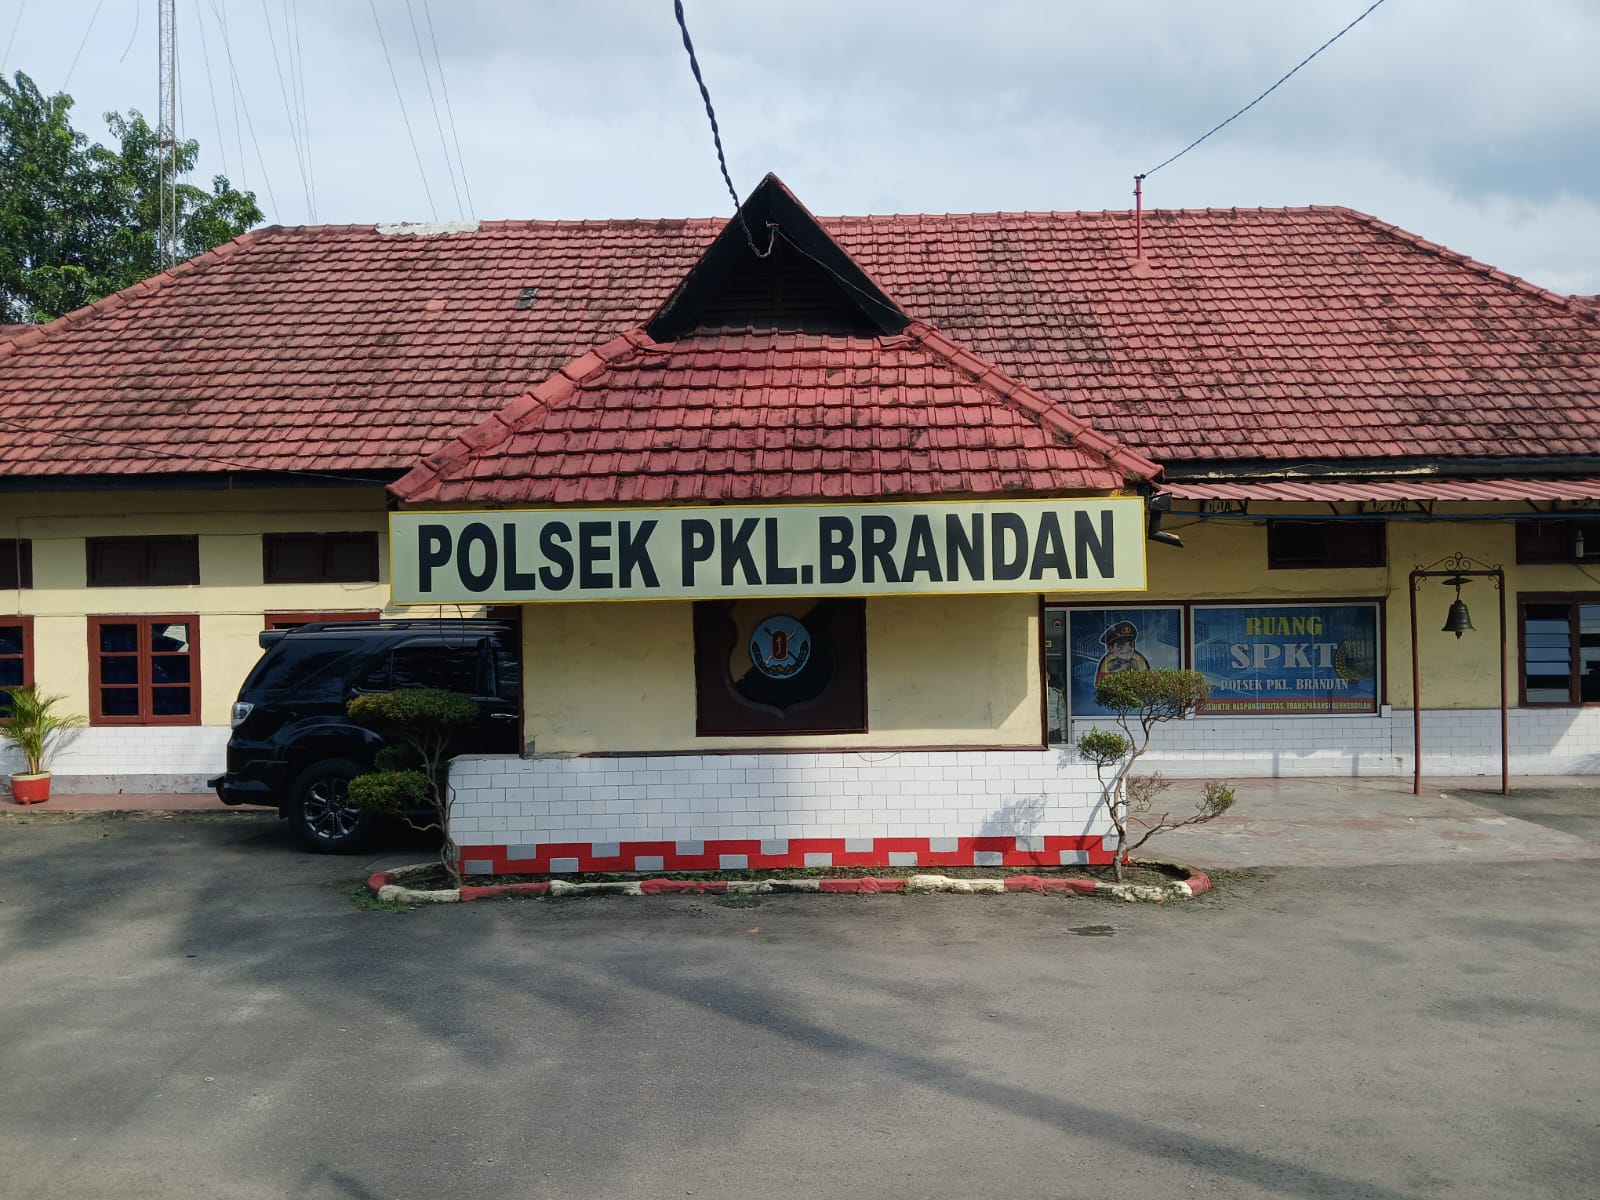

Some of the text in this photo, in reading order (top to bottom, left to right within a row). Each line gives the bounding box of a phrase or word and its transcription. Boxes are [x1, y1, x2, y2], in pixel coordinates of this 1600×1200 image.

[418, 510, 1115, 593] POLSEK PKL.BRANDAN
[1245, 616, 1323, 636] RUANG
[1230, 643, 1338, 669] SPKT
[1220, 678, 1349, 691] POLSEK PKL. BRANDAN
